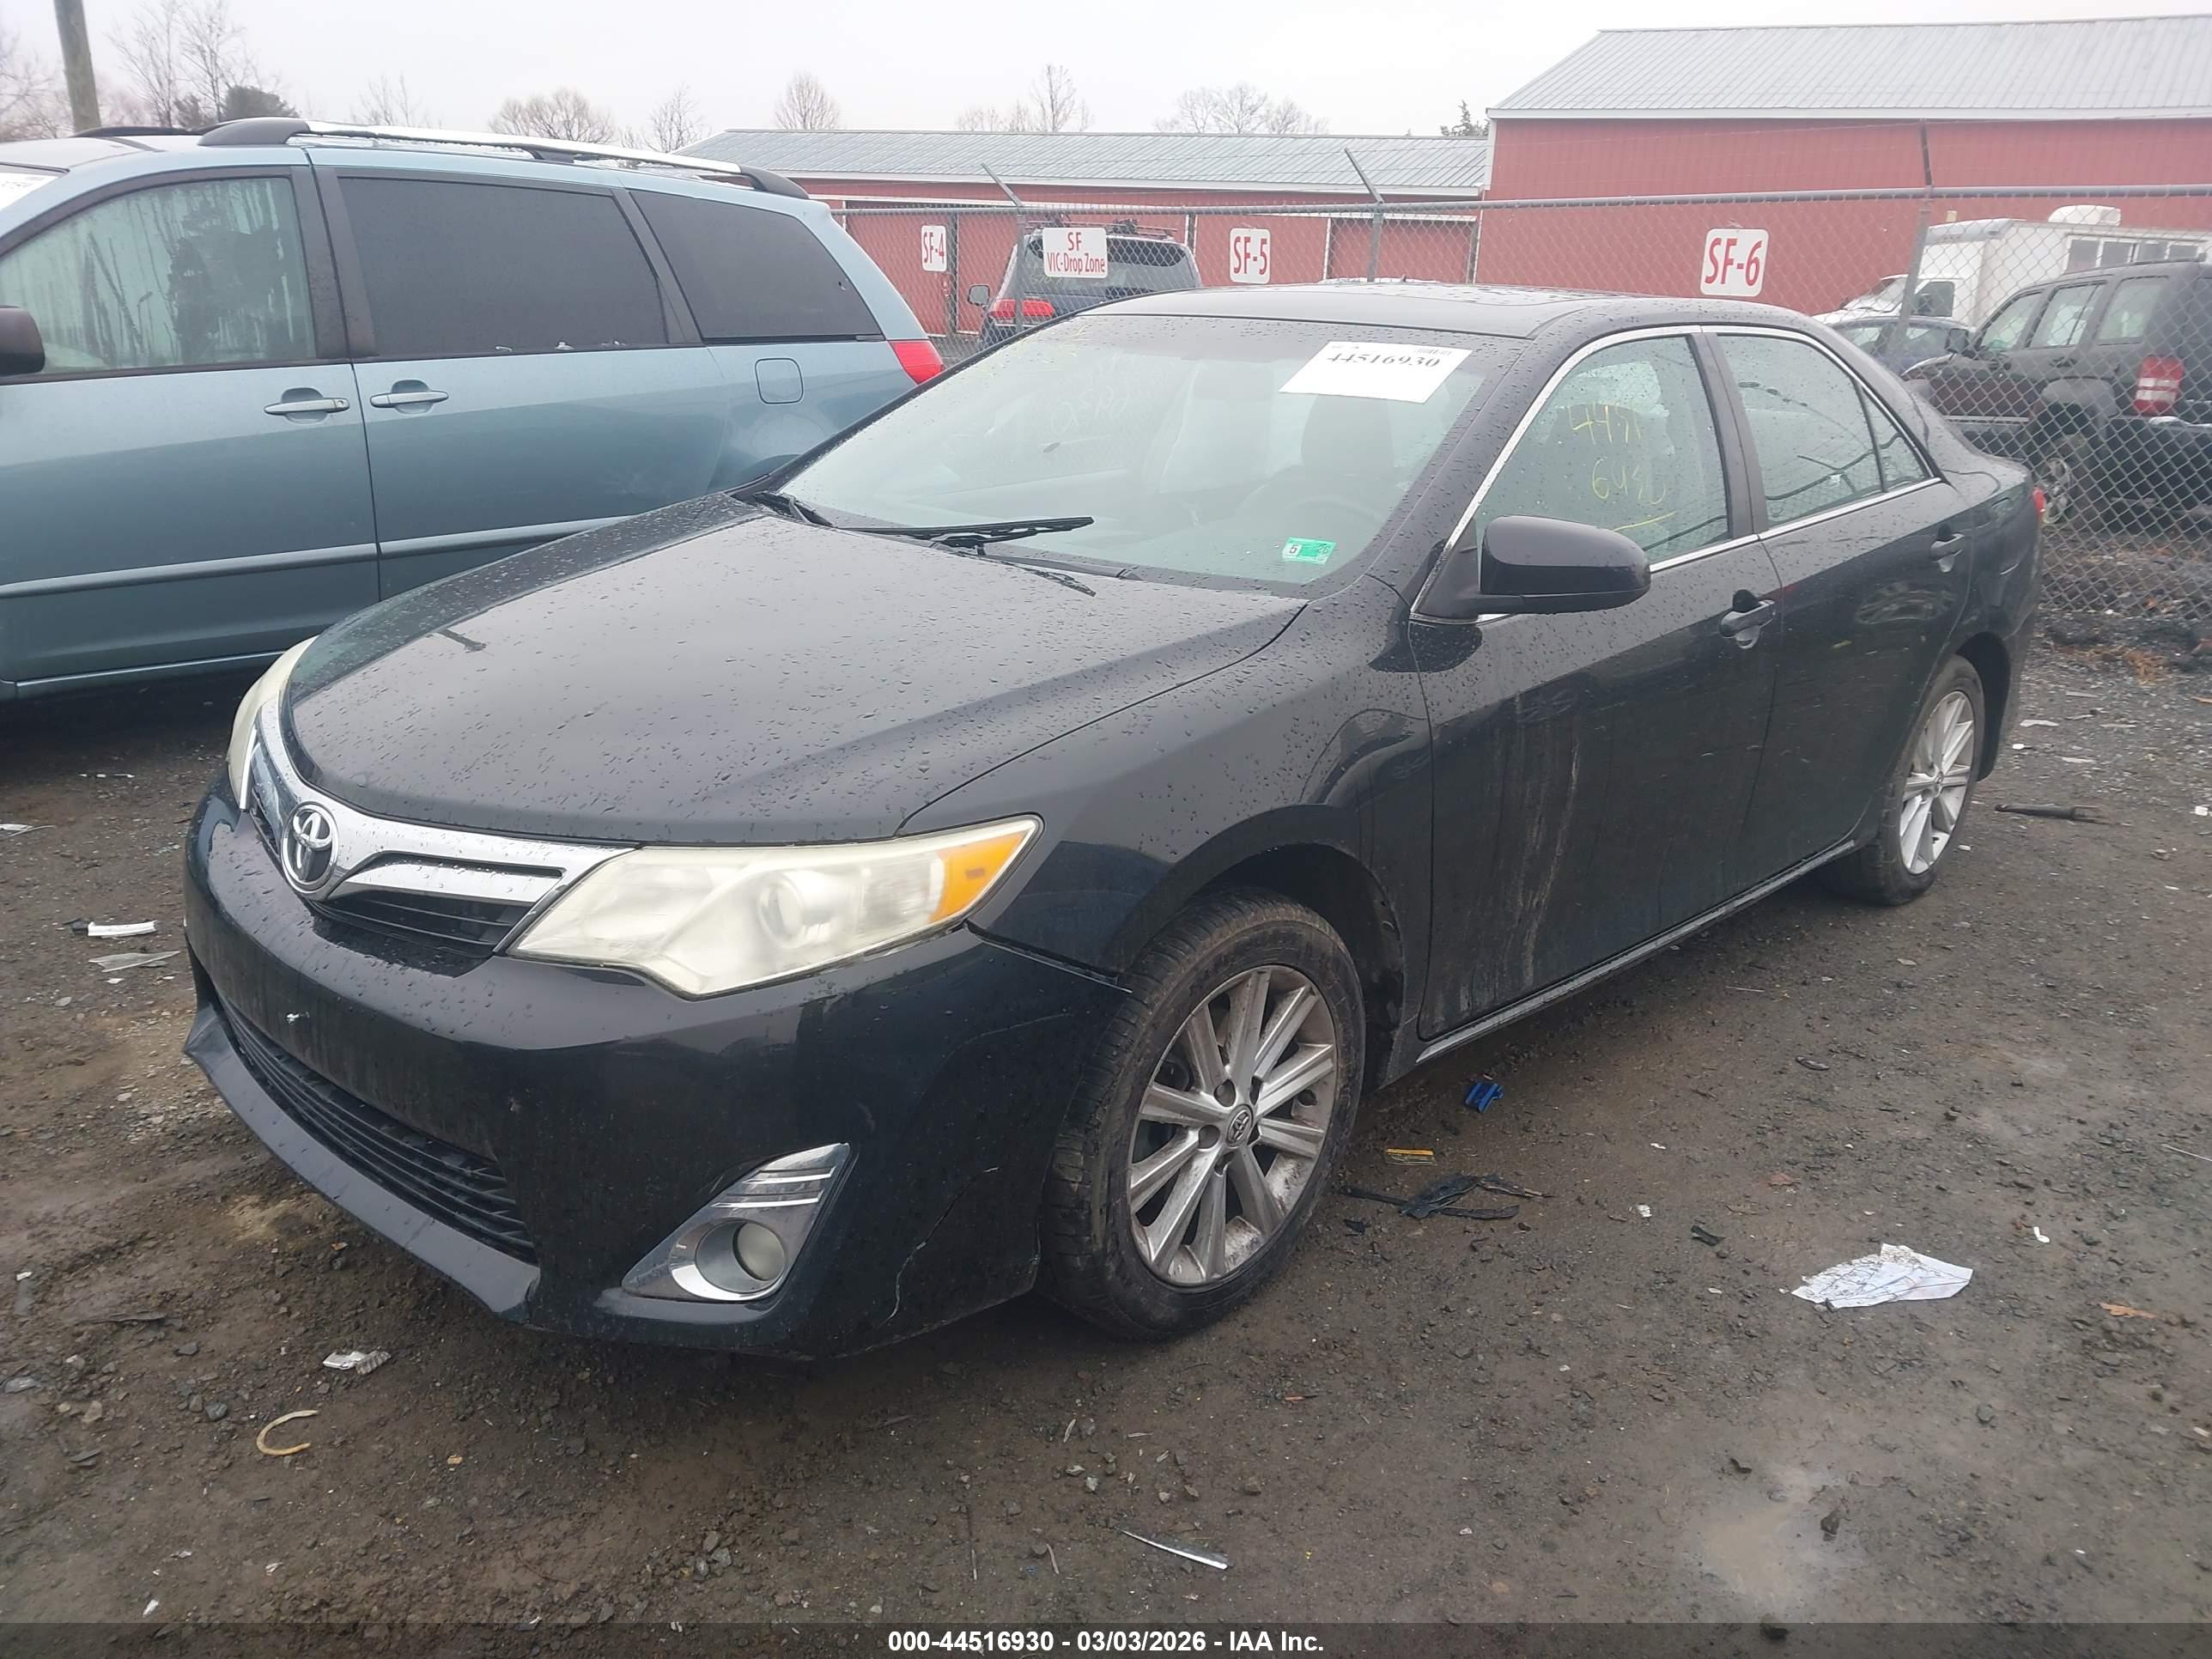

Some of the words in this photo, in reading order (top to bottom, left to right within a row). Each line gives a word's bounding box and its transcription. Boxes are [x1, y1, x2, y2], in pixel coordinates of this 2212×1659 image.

[923, 232, 945, 264] SF-4
[1067, 232, 1082, 251] SF
[1047, 252, 1083, 275] VIC-Drop
[1085, 252, 1106, 273] Zone
[1233, 235, 1267, 276] SF-5
[1705, 237, 1762, 287] SF-6
[1326, 353, 1441, 368] 44516930
